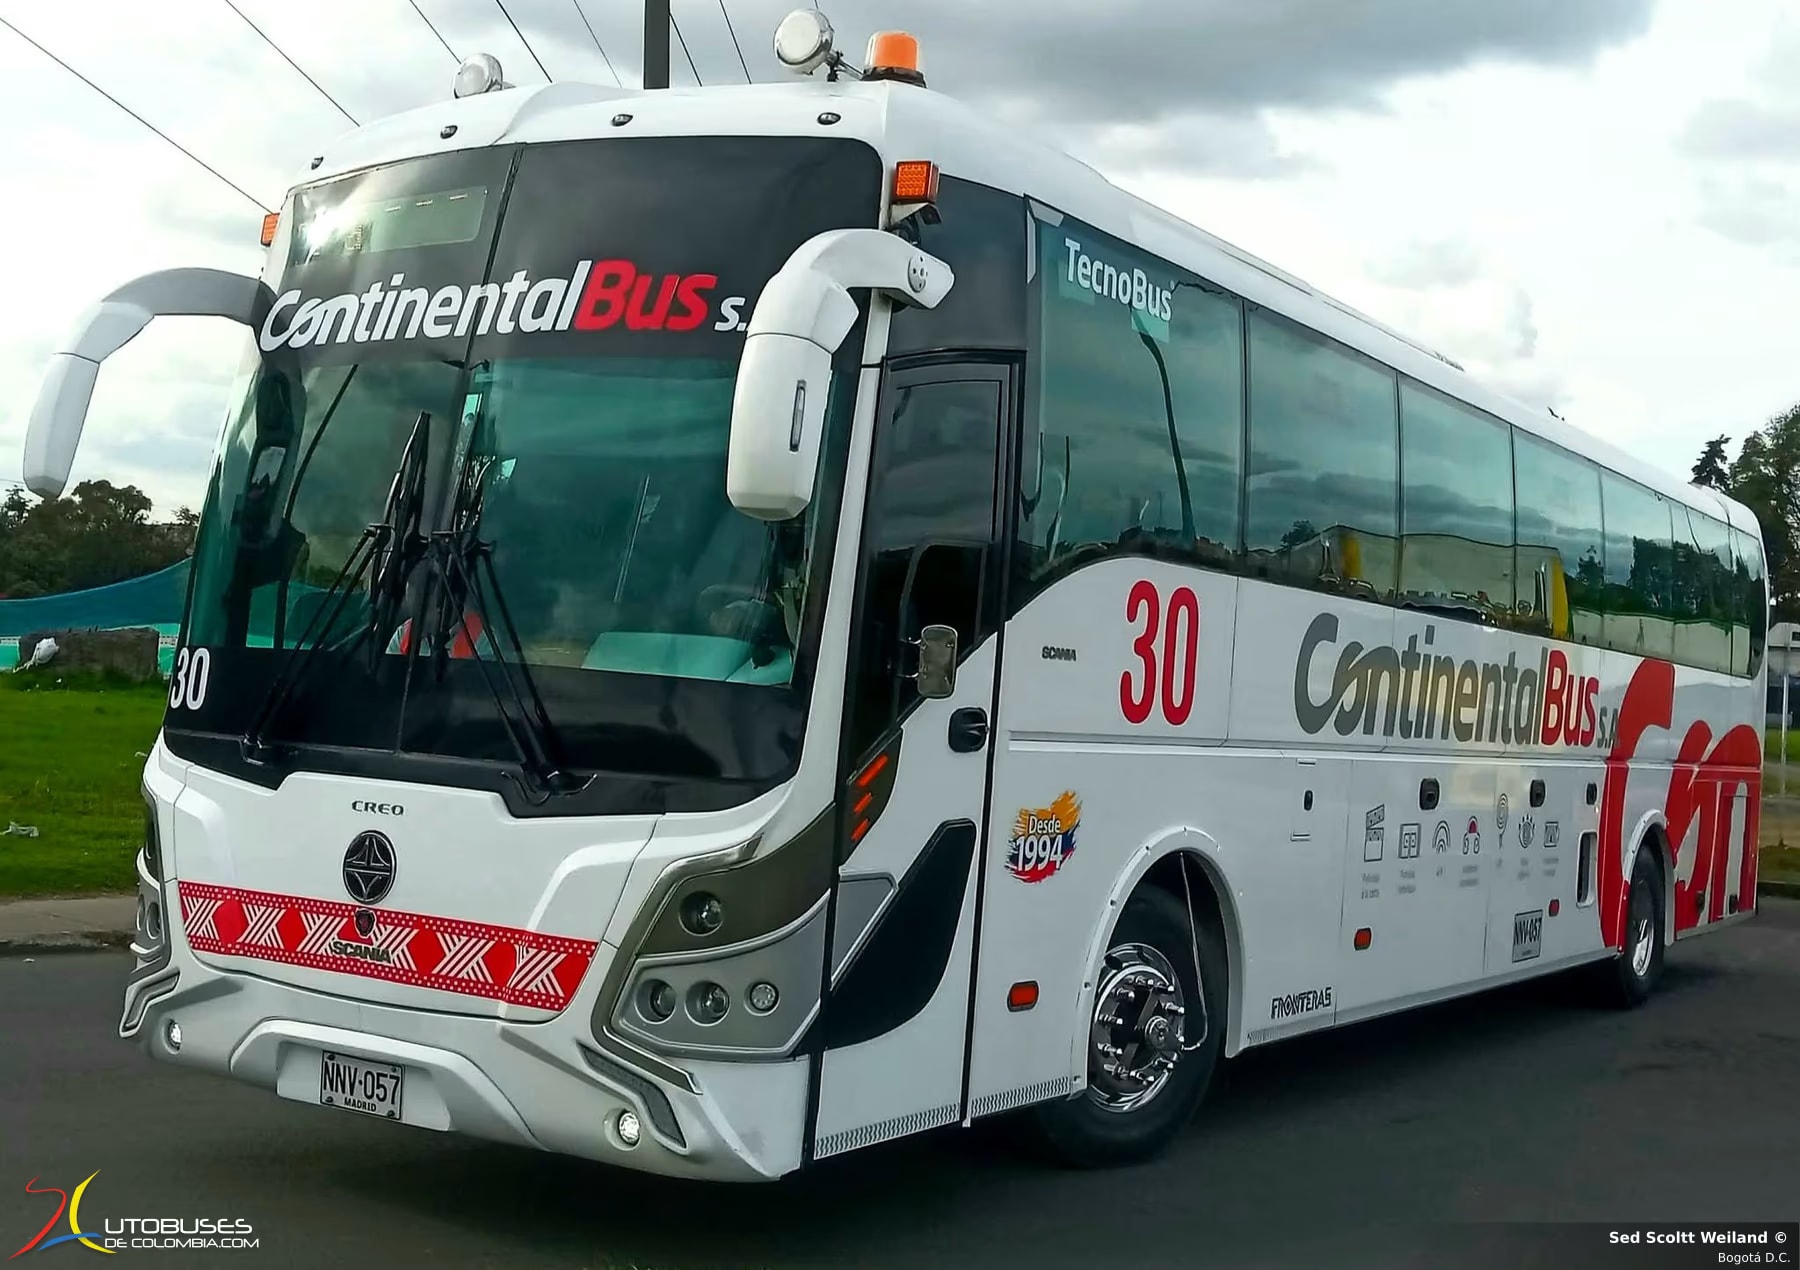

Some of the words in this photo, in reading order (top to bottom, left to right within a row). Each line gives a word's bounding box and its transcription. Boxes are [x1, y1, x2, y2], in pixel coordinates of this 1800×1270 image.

[1064, 237, 1173, 321] TecnoBus
[259, 259, 718, 352] ContinentalBus
[714, 296, 747, 332] S.
[1041, 645, 1077, 662] SCANIA
[1119, 579, 1200, 726] 30
[170, 647, 210, 711] 30
[1294, 612, 1599, 747] ContinentalBus
[351, 800, 405, 816] CREO
[1029, 815, 1061, 833] Desde
[1016, 834, 1063, 872] 1994
[332, 940, 392, 964] SCANIA
[1271, 986, 1332, 1019] FRONTERAS
[344, 1097, 377, 1112] MADRID
